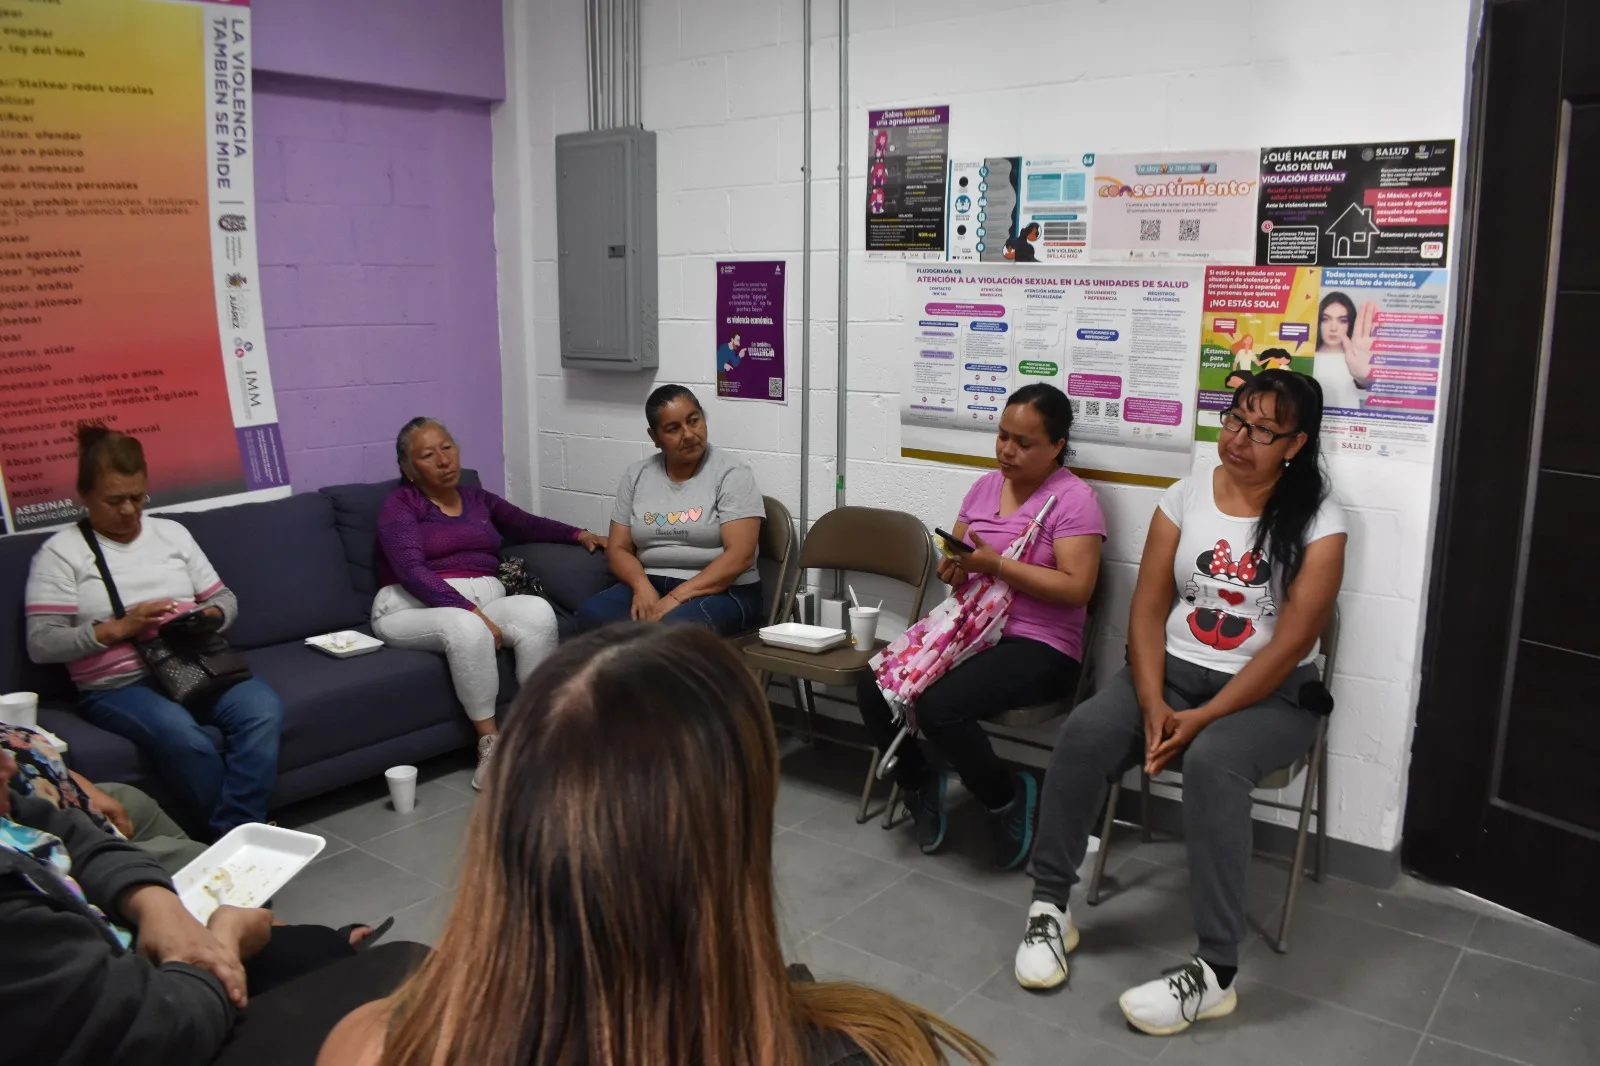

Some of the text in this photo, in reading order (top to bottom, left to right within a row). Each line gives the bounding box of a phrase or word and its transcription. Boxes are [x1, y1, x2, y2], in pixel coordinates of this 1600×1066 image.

[231, 19, 244, 43] LA
[212, 18, 231, 190] TAMBIÉN SE MIDE
[232, 52, 247, 159] VIOLENCIA
[904, 108, 935, 117] identificar
[889, 116, 915, 127] agresión
[916, 115, 941, 123] sexual?
[1262, 149, 1347, 165] ¿QUÉ HACER EN
[1375, 147, 1410, 156] SALUD
[1275, 161, 1334, 172] CASO DE UNA
[1261, 172, 1347, 183] VIOLACIÓN SEXUAL?
[916, 275, 956, 284] ATENCIÓN
[978, 275, 1023, 285] VIOLACIÓN
[1025, 278, 1059, 286] SEXUAL
[1093, 279, 1140, 287] UNIDADES
[1210, 299, 1280, 308] ¡NO ESTÁS SOLA!
[245, 370, 262, 408] IMM
[1341, 442, 1372, 451] SALUD
[16, 498, 73, 515] ASESINAR
